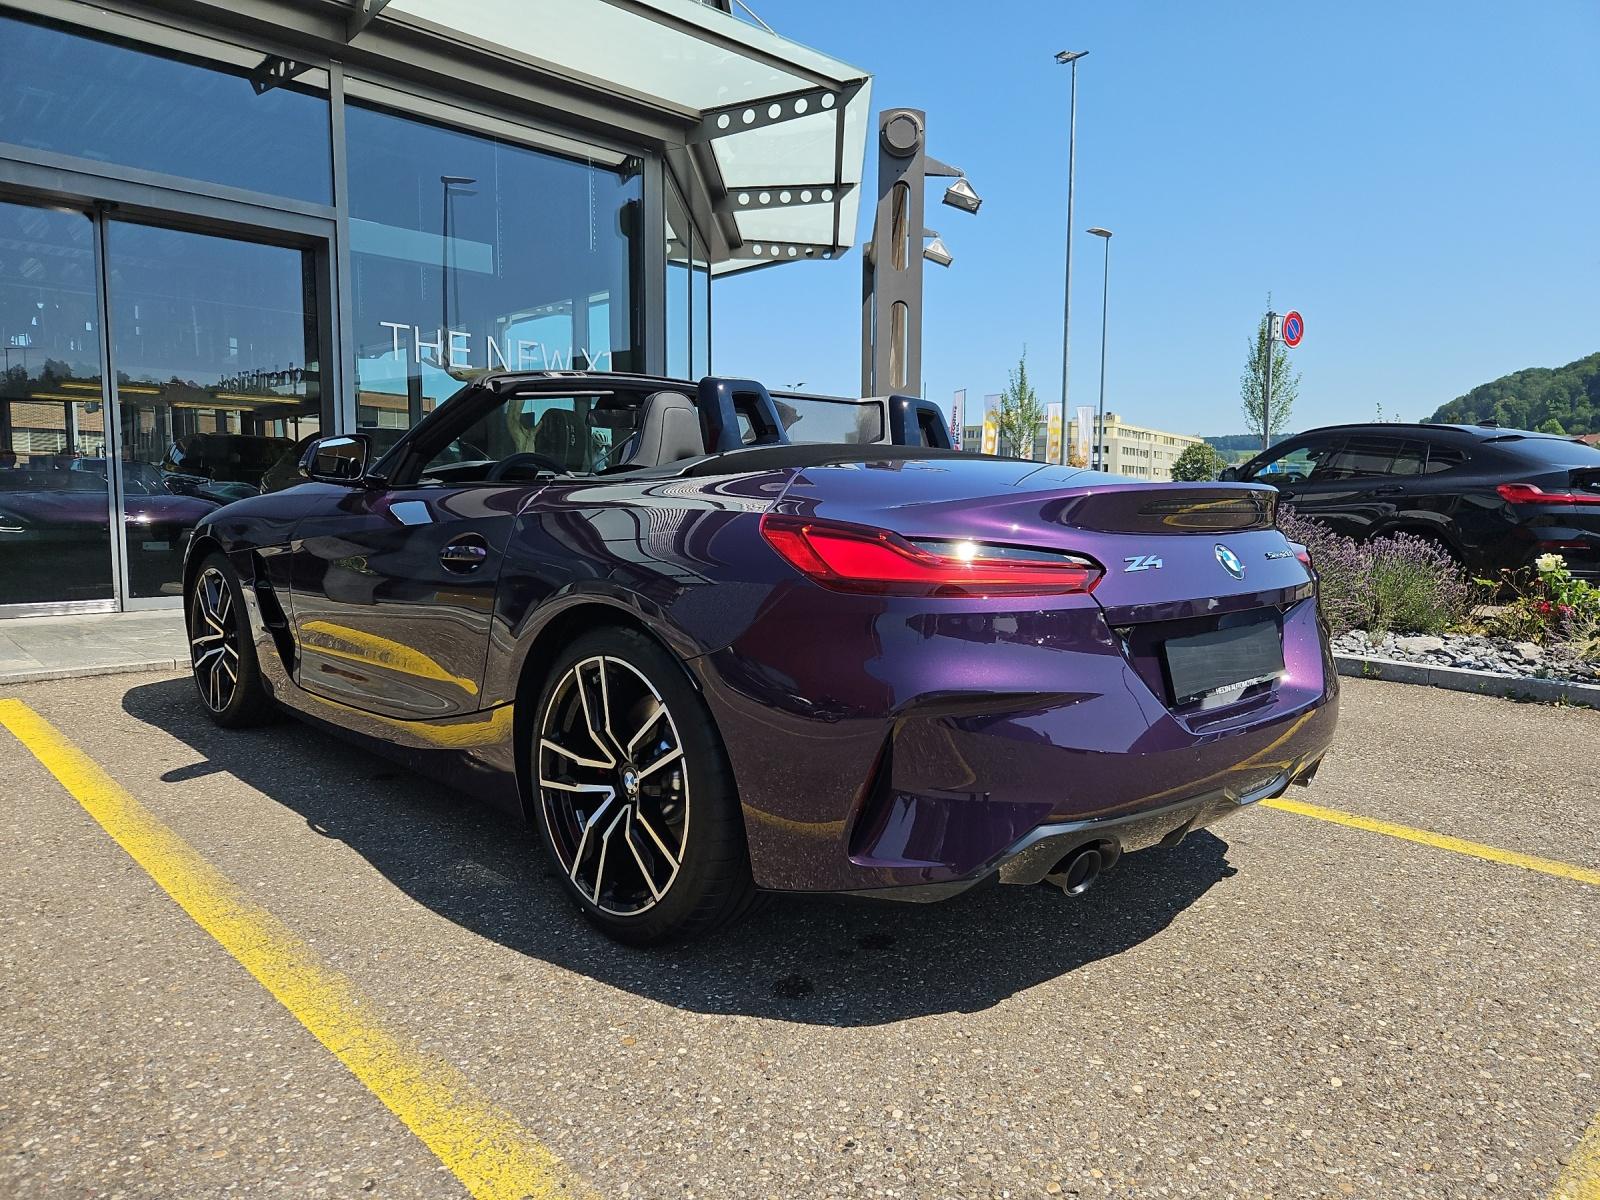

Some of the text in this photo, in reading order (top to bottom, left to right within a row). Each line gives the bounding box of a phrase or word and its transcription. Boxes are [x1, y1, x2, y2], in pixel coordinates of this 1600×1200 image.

[379, 321, 473, 370] THE
[581, 348, 613, 372] X1
[1124, 555, 1163, 573] Z4
